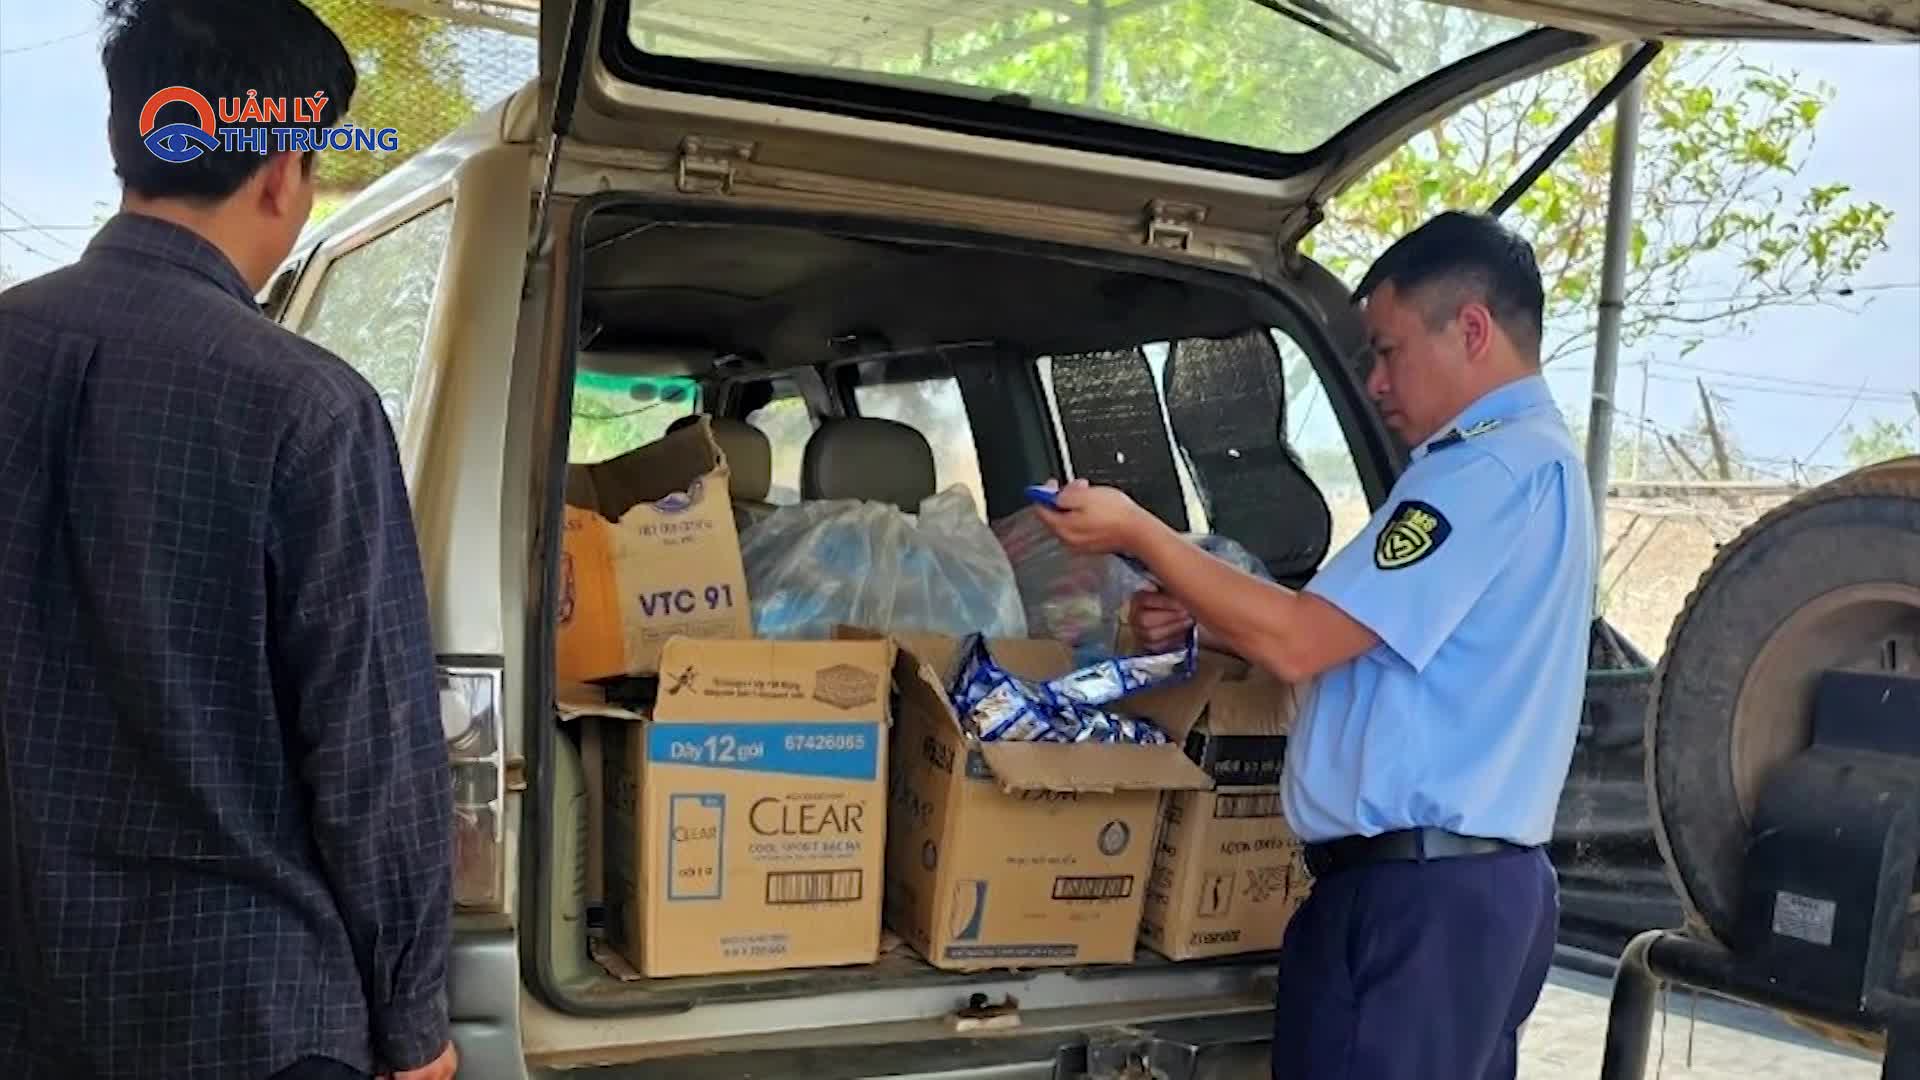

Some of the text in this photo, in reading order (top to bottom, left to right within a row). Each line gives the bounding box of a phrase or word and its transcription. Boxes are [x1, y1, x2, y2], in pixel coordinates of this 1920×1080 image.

[639, 583, 733, 617] VTC 91
[703, 735, 737, 761] 12
[749, 796, 864, 836] CLEAR
